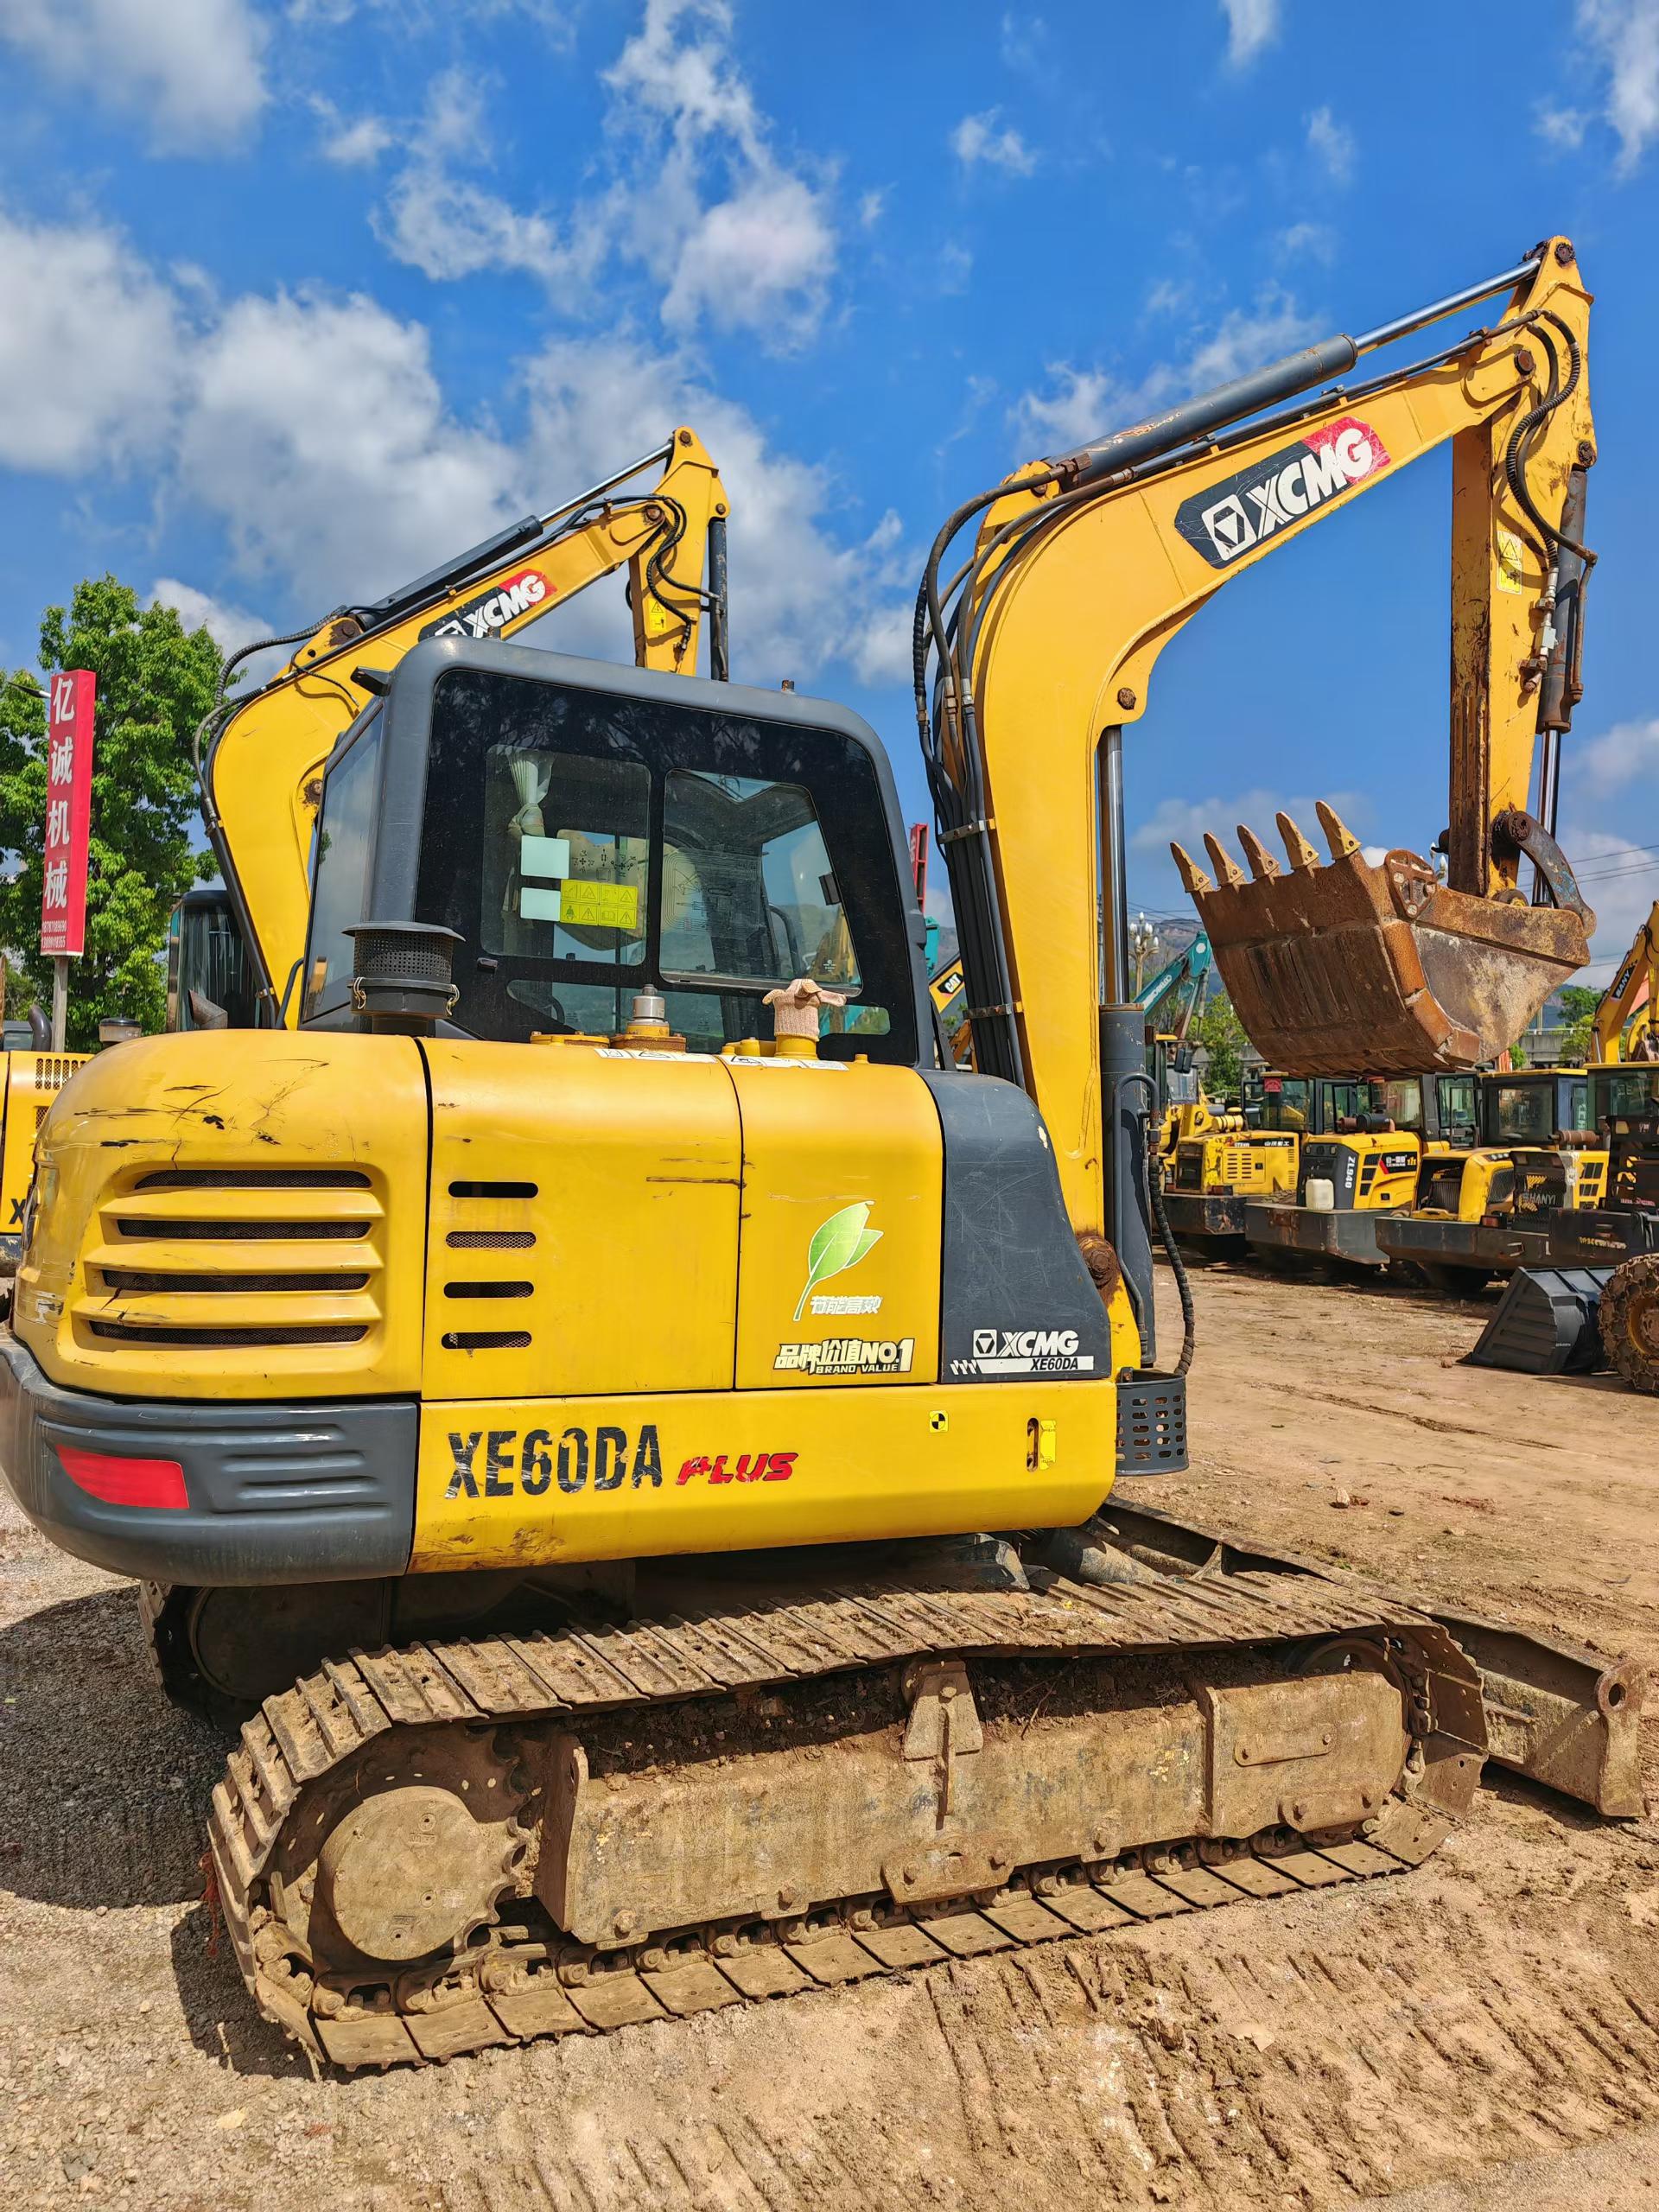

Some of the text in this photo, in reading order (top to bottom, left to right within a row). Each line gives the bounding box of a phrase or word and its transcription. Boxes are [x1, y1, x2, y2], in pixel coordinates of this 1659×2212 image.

[1246, 428, 1374, 540] XCMG
[462, 575, 546, 639] XCMG
[45, 677, 74, 909] 亿诚机械
[944, 973, 961, 992] CAT
[1344, 1155, 1356, 1189] ZL940
[810, 1295, 883, 1315] 节能高效
[996, 1330, 1079, 1357] XCMG
[816, 1363, 899, 1375] BRAND VALUE
[1030, 1357, 1078, 1371] XE60DA
[443, 1424, 799, 1499] XE60DA PLUS
